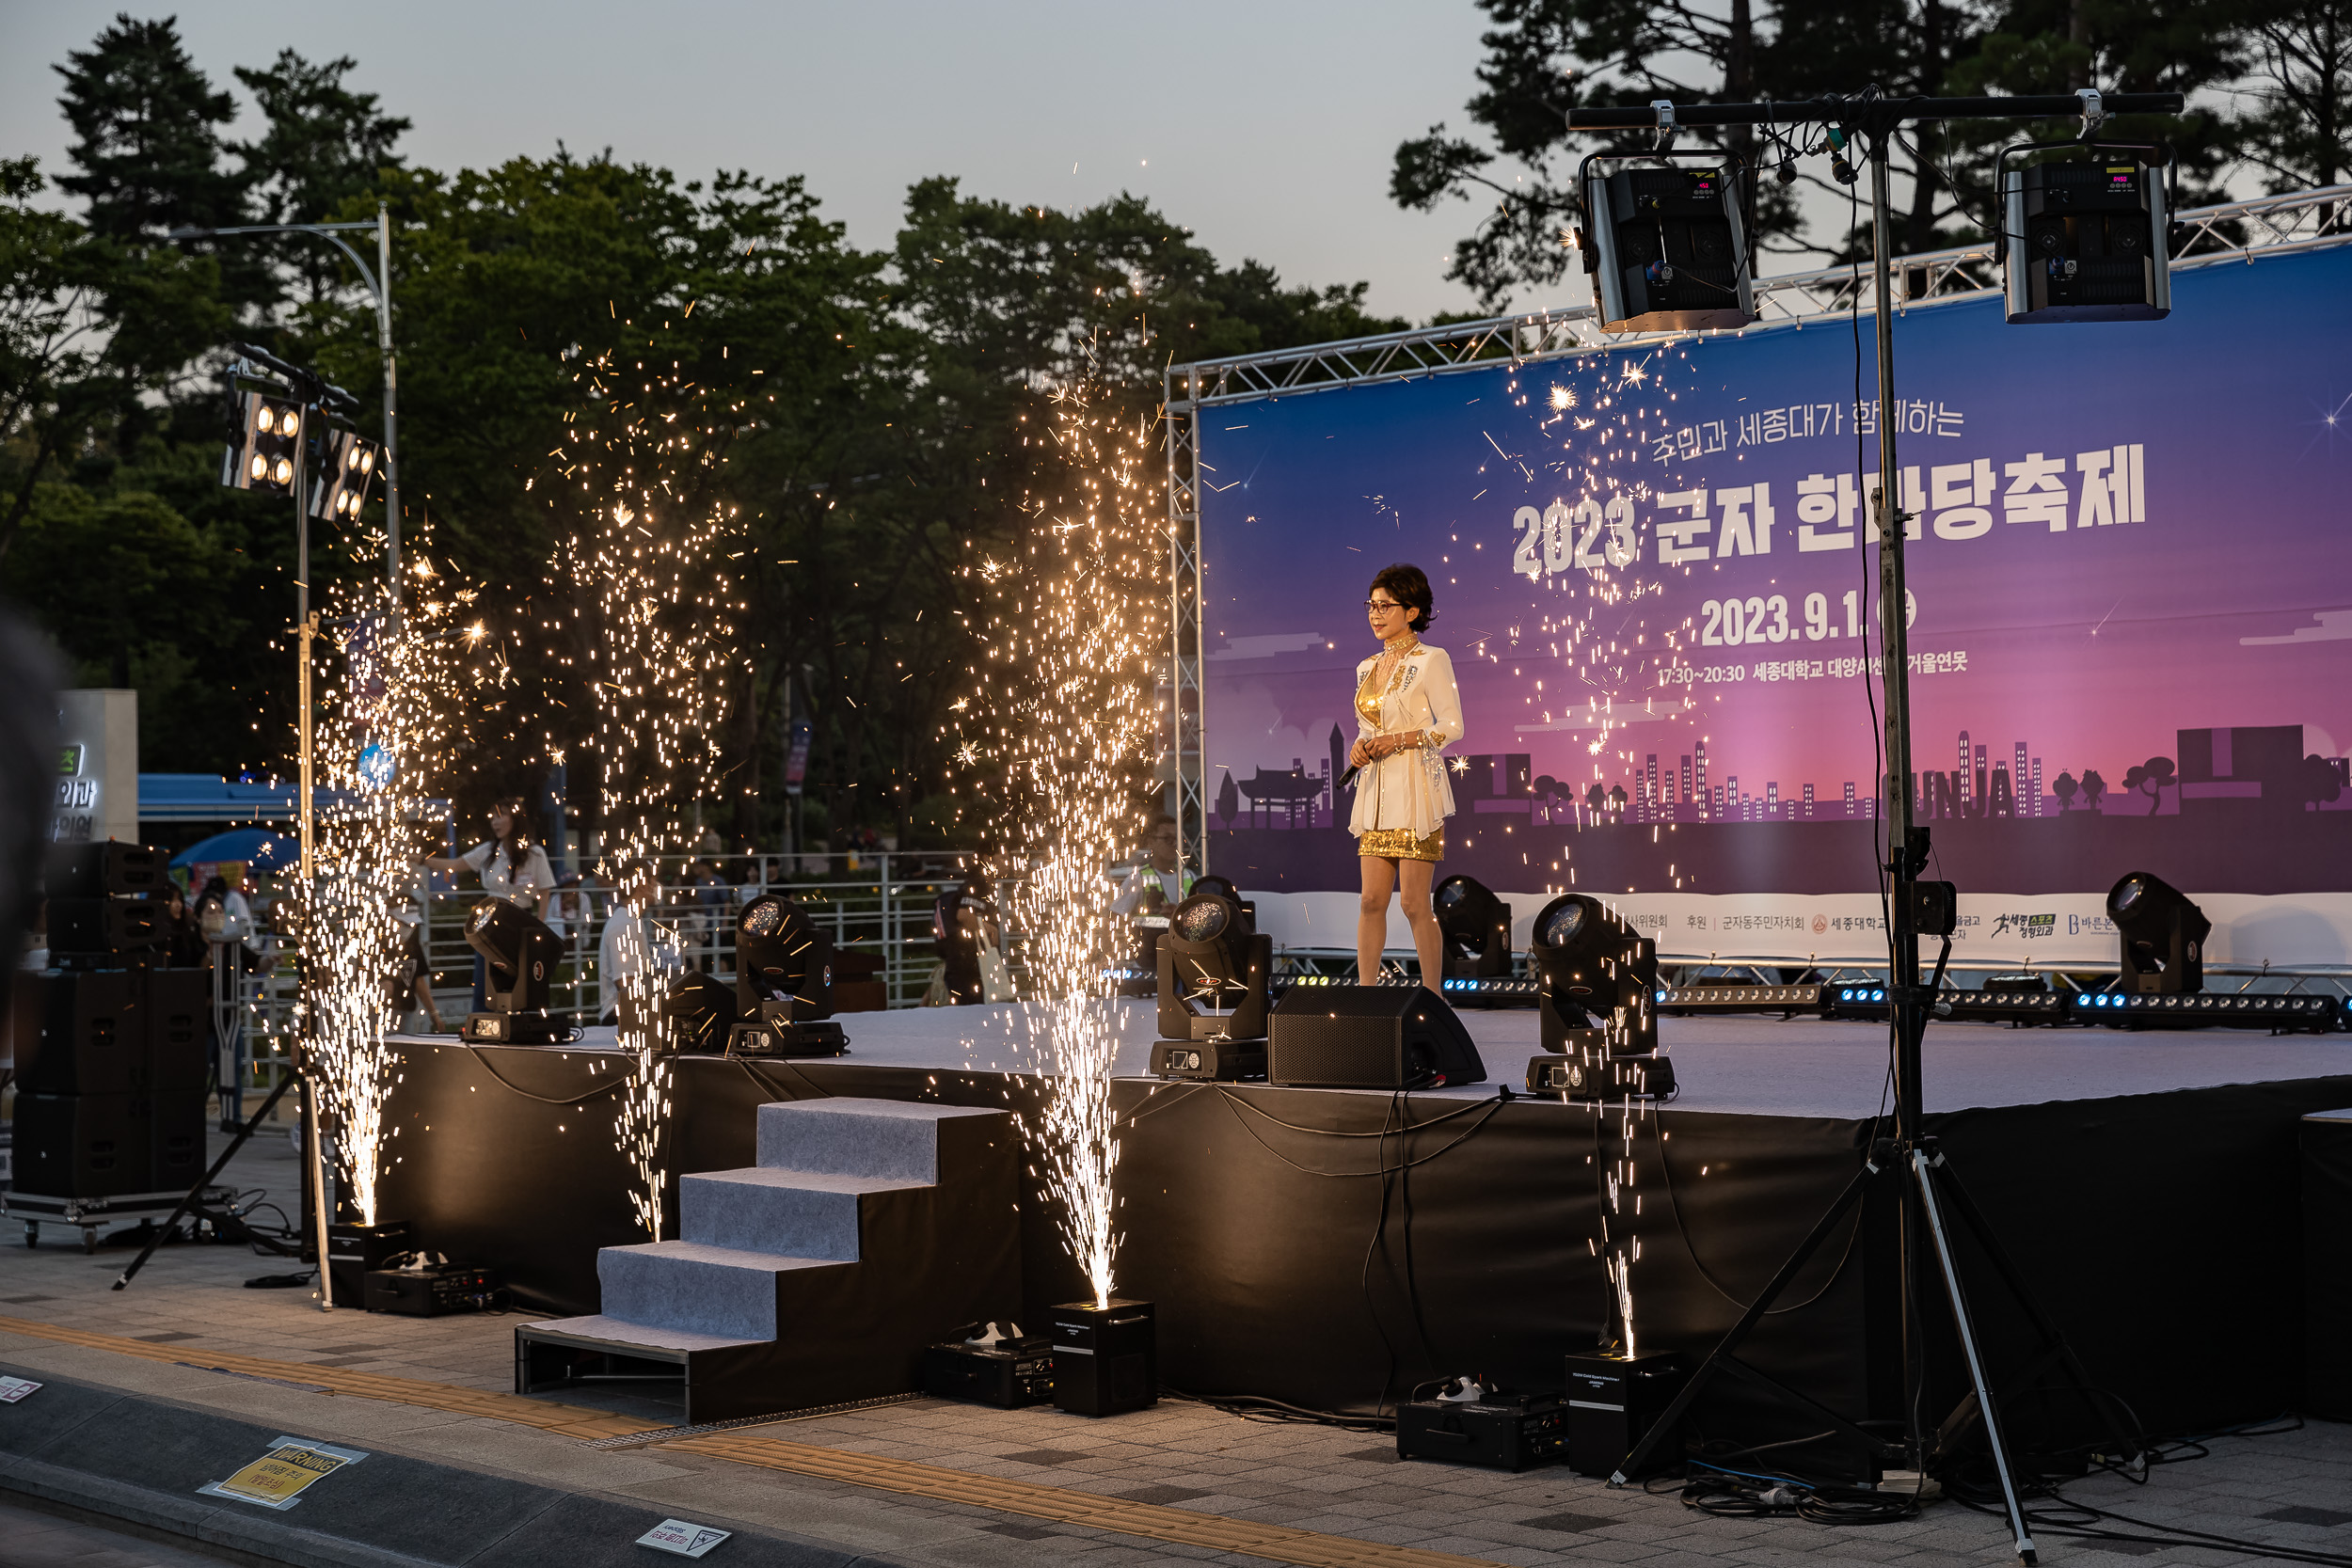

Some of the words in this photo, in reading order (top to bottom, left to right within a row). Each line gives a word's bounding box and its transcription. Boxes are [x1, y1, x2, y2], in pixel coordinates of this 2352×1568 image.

[1651, 420, 1728, 467] 주민과
[1736, 403, 1843, 448] 세종대가
[1513, 496, 1637, 575] 2023
[1656, 482, 1775, 563] 군자
[1658, 665, 1745, 685] 17:30~20:30
[1752, 659, 1824, 683] 세종대학교
[1827, 656, 1885, 679] 대양AI센
[1908, 650, 1968, 674] 거울연못
[1882, 769, 2015, 819] UNJA
[1625, 913, 1668, 928] 사위원회
[1687, 915, 1707, 930] 후원
[1722, 915, 1804, 931] 군자동주민자치회
[1831, 916, 1886, 931] 세종대학교
[1956, 915, 1980, 927] 을금고
[2009, 913, 2028, 927] 세종
[2029, 914, 2054, 926] 스포츠
[2081, 916, 2114, 930] 바른본
[273, 1449, 337, 1471] WARNING
[259, 1463, 290, 1475] 넘어짐
[284, 1469, 306, 1481] 주의
[649, 1530, 667, 1540] 주의
[665, 1533, 689, 1544] 미끄럼
